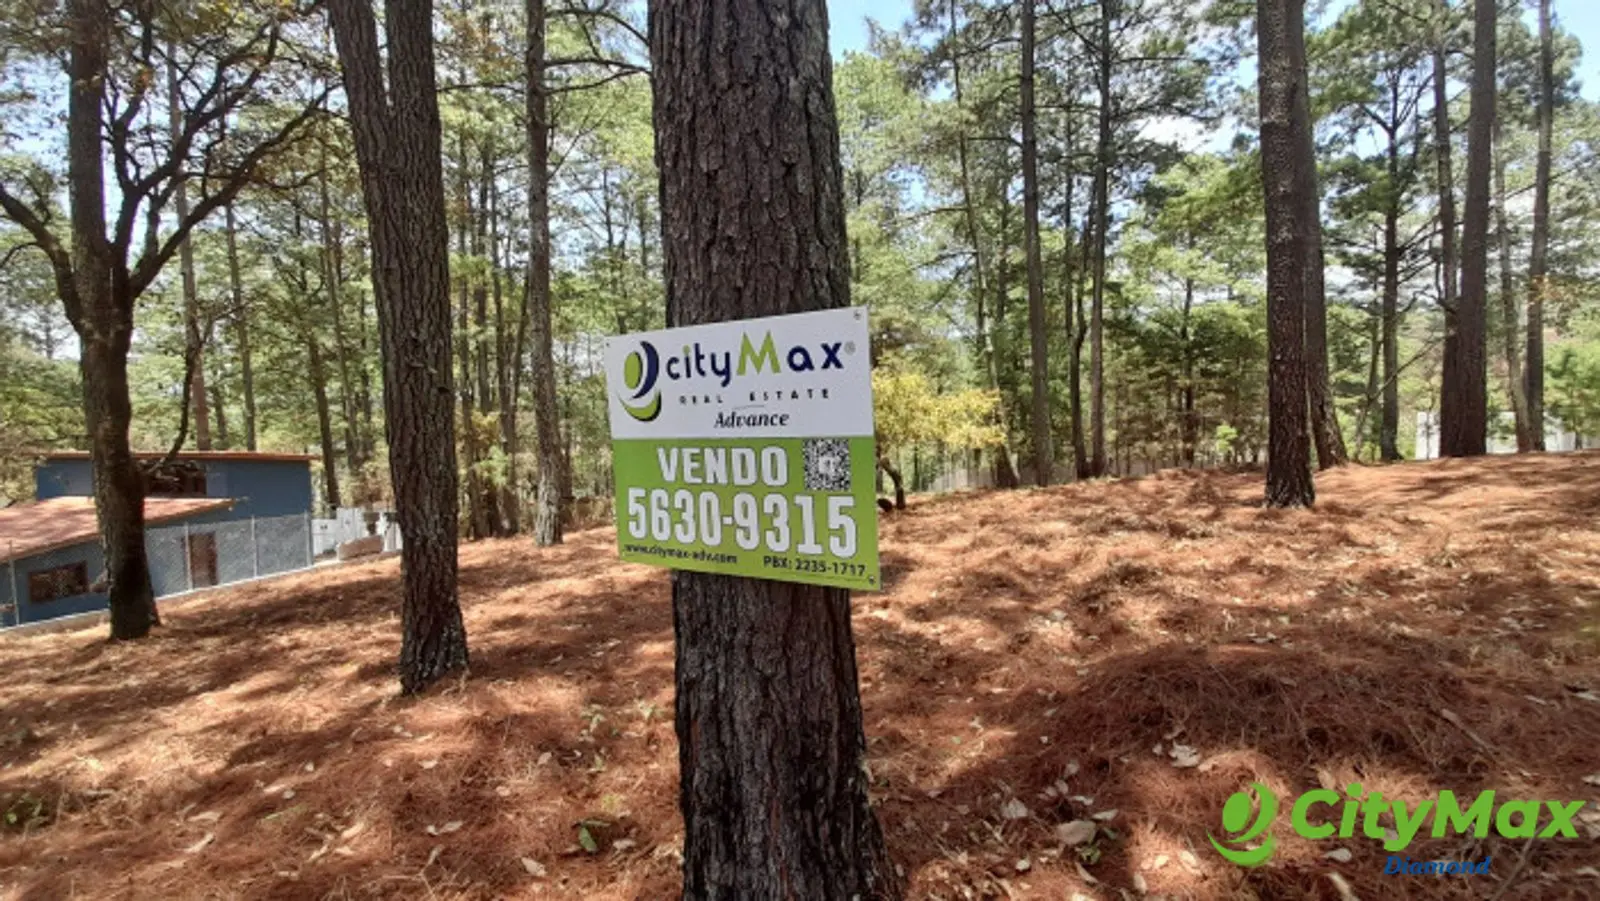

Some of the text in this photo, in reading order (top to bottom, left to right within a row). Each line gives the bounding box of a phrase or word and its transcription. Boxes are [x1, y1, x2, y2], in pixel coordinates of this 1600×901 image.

[679, 388, 829, 405] REAL ESTATE
[714, 410, 790, 429] Advance
[657, 446, 789, 487] VENDO
[627, 487, 857, 559] 5630-9315
[763, 556, 792, 569] PBX:
[795, 558, 866, 577] 2235-1717
